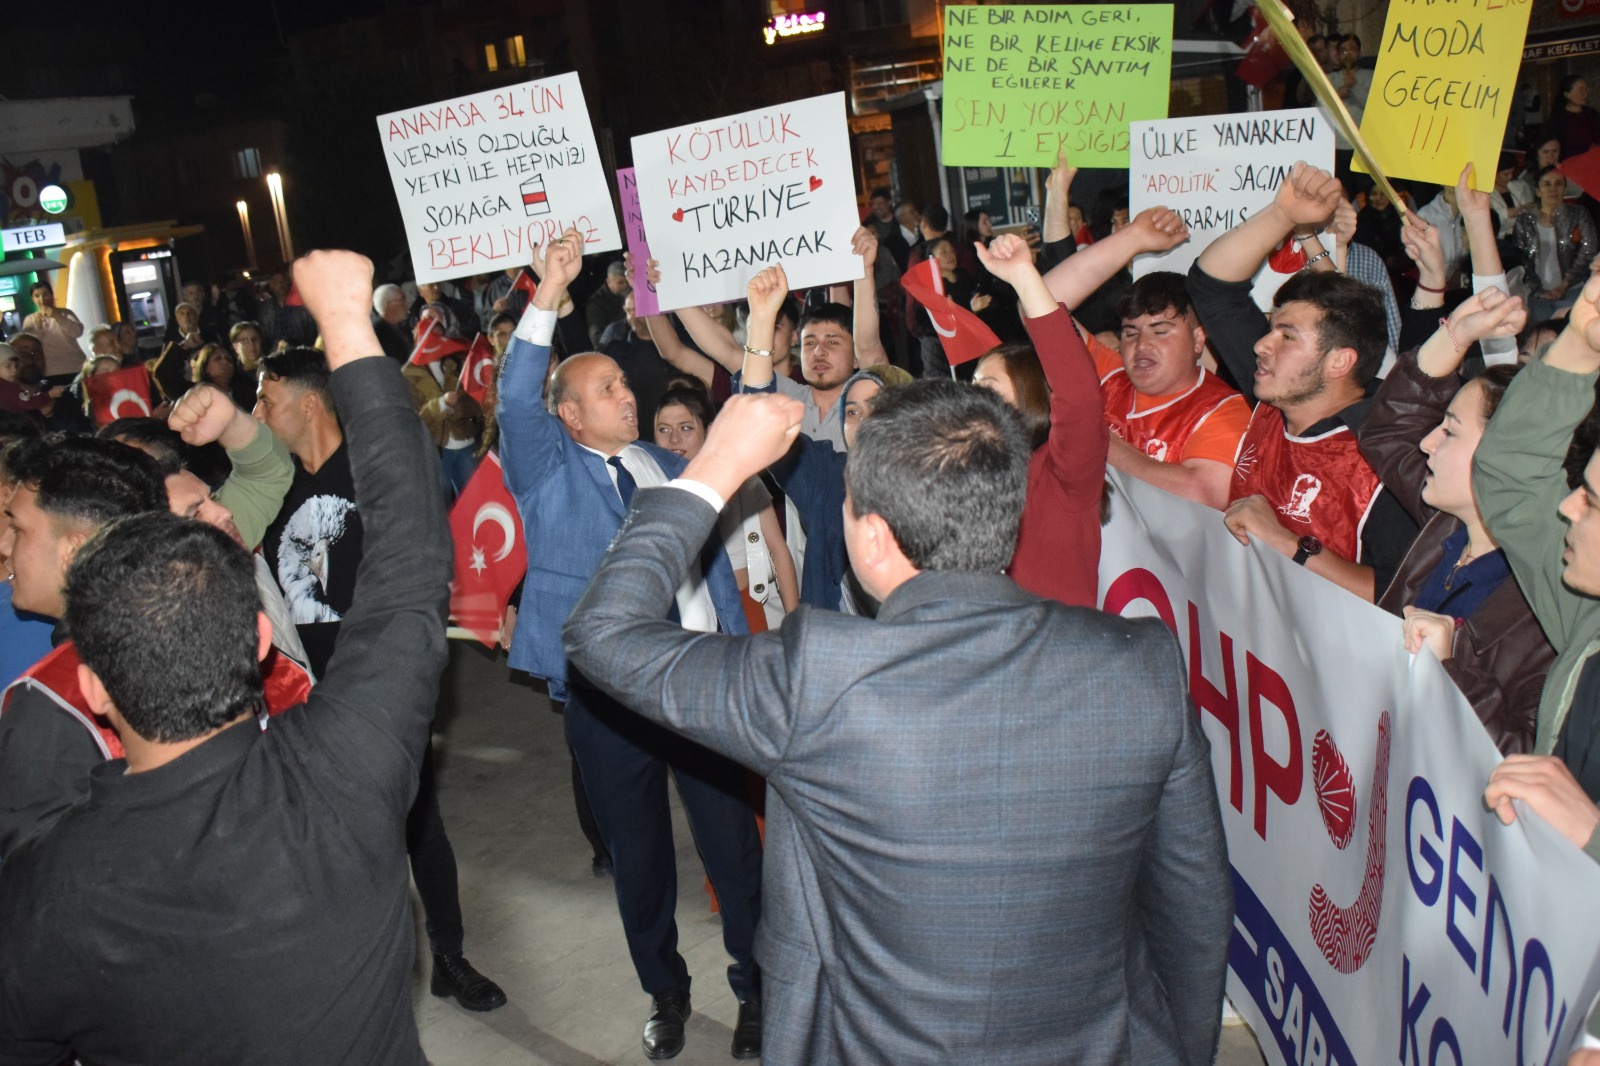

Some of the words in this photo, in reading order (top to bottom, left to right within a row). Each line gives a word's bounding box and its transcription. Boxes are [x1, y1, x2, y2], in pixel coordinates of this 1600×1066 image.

[949, 9, 979, 26] NE
[1023, 10, 1073, 25] ADIM
[947, 35, 974, 48] NE
[990, 32, 1023, 52] BİR
[1036, 32, 1105, 54] KELİME
[1388, 19, 1485, 58] MODA
[946, 57, 976, 72] NE
[986, 58, 1009, 72] DE
[1028, 55, 1058, 73] BİR
[1069, 57, 1150, 77] SANTİM
[388, 101, 487, 142] ANAYASA
[952, 97, 1006, 132] SEN
[1022, 99, 1125, 126] YOKSAN
[477, 125, 570, 154] OLDUĞU
[666, 112, 801, 165] KÖTÜLÜK
[1142, 126, 1198, 160] ÜLKE
[1213, 116, 1316, 148] YANARKEN
[404, 163, 461, 197] YETKİ
[466, 161, 499, 182] İLE
[668, 147, 819, 199] KAYBEDECEK
[423, 195, 512, 233] SOKAĞA
[683, 181, 811, 232] TÜRKİYE
[12, 228, 47, 246] TEB
[682, 230, 833, 283] KAZANACAK
